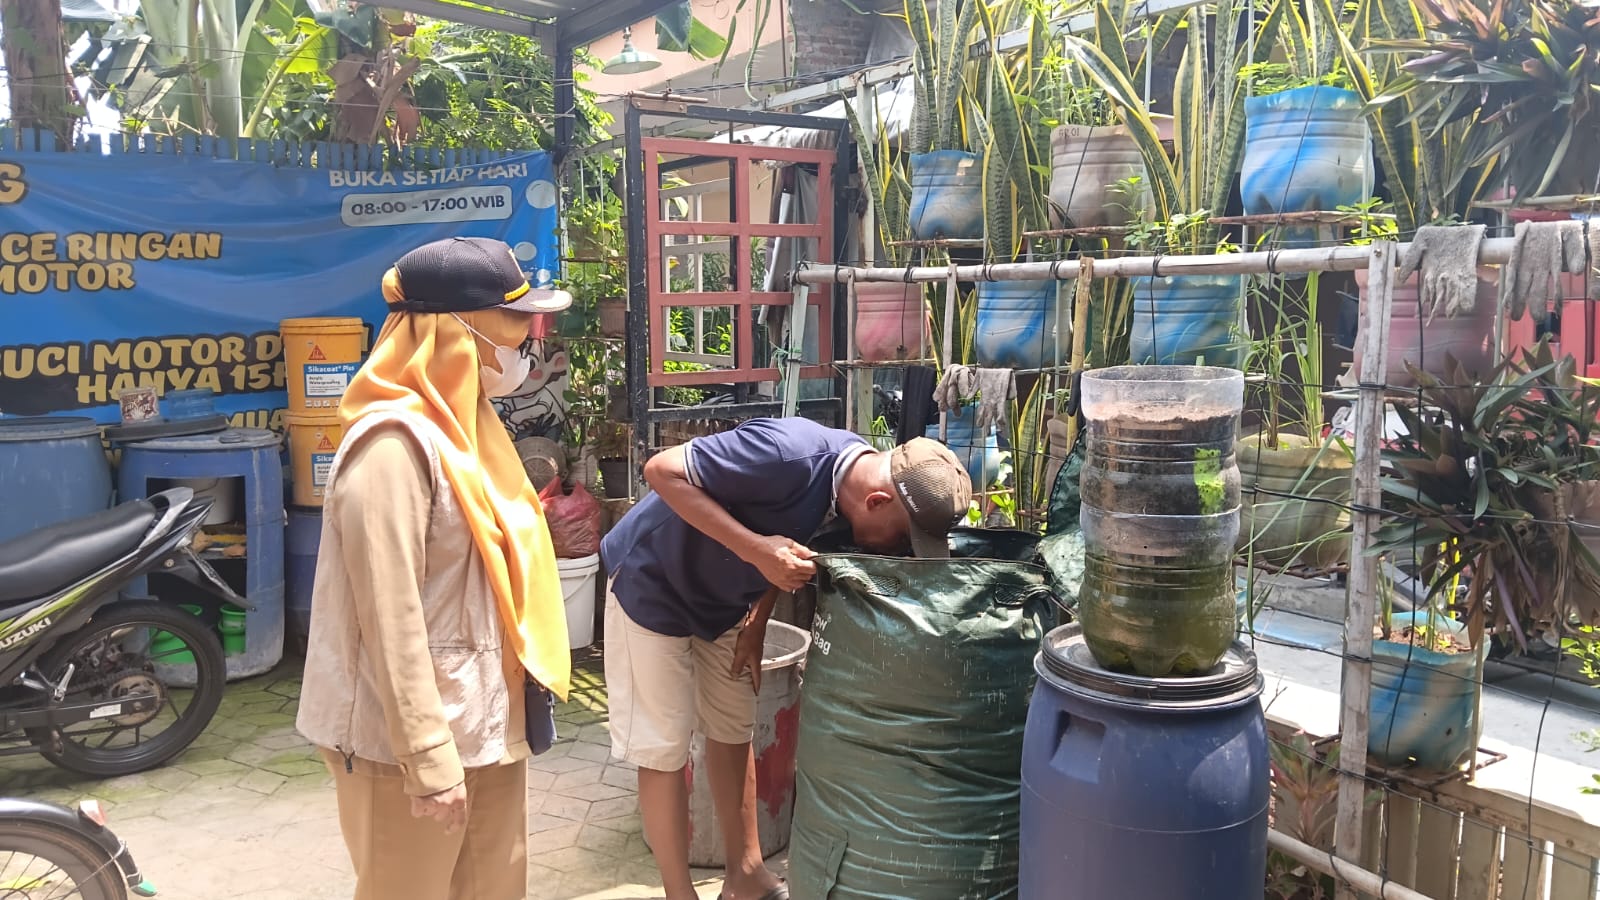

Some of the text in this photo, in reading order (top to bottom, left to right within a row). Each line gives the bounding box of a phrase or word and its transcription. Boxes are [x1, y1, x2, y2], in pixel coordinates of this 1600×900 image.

[328, 162, 528, 187] BUKA SETIAP HARI
[351, 201, 407, 216] 08:00
[422, 197, 468, 212] 17:00
[471, 194, 505, 209] WIB
[66, 232, 222, 261] RINGAN
[0, 345, 80, 379] UCI
[93, 336, 247, 372] MOTOR
[76, 366, 222, 403] HANYA
[0, 617, 52, 650] UZUKI
